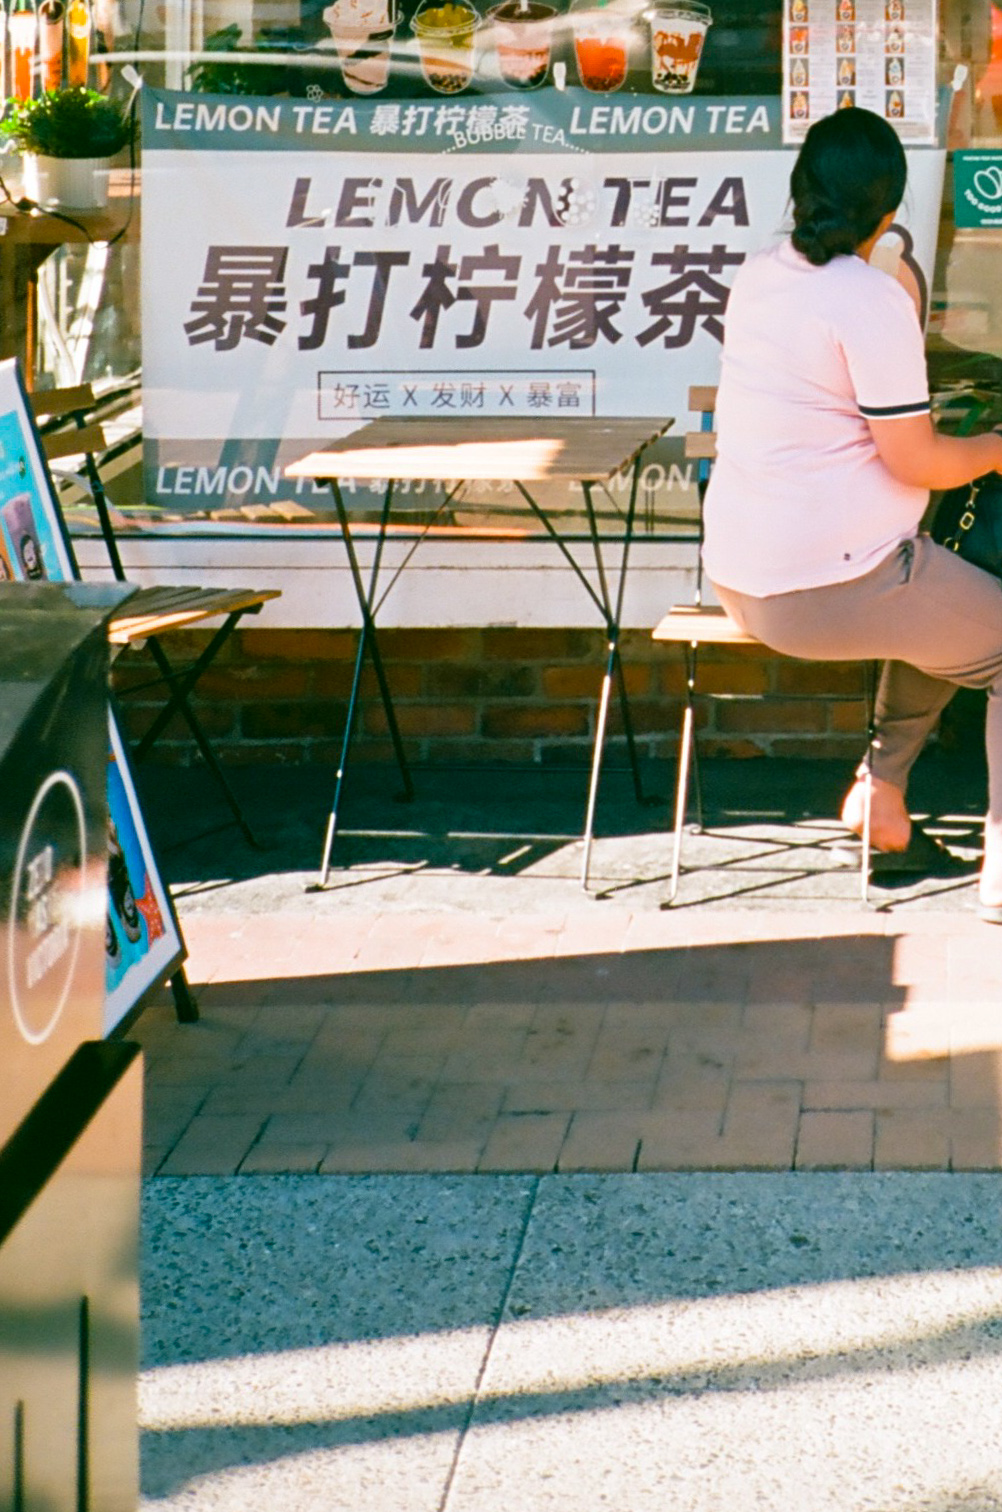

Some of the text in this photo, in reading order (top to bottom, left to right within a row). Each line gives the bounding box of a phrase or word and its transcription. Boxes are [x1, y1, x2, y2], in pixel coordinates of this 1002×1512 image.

[155, 102, 358, 134] LEMON TEA
[369, 103, 530, 138] 暴打柠檬茶
[569, 106, 771, 135] LEMON TEA
[453, 122, 566, 150] BUBBLE TEA
[285, 176, 750, 229] LEMON TEA
[183, 244, 746, 352] 暴打柠檬茶
[334, 381, 582, 409] 好运 X 发财 X 暴富
[156, 466, 280, 495] LEMON
